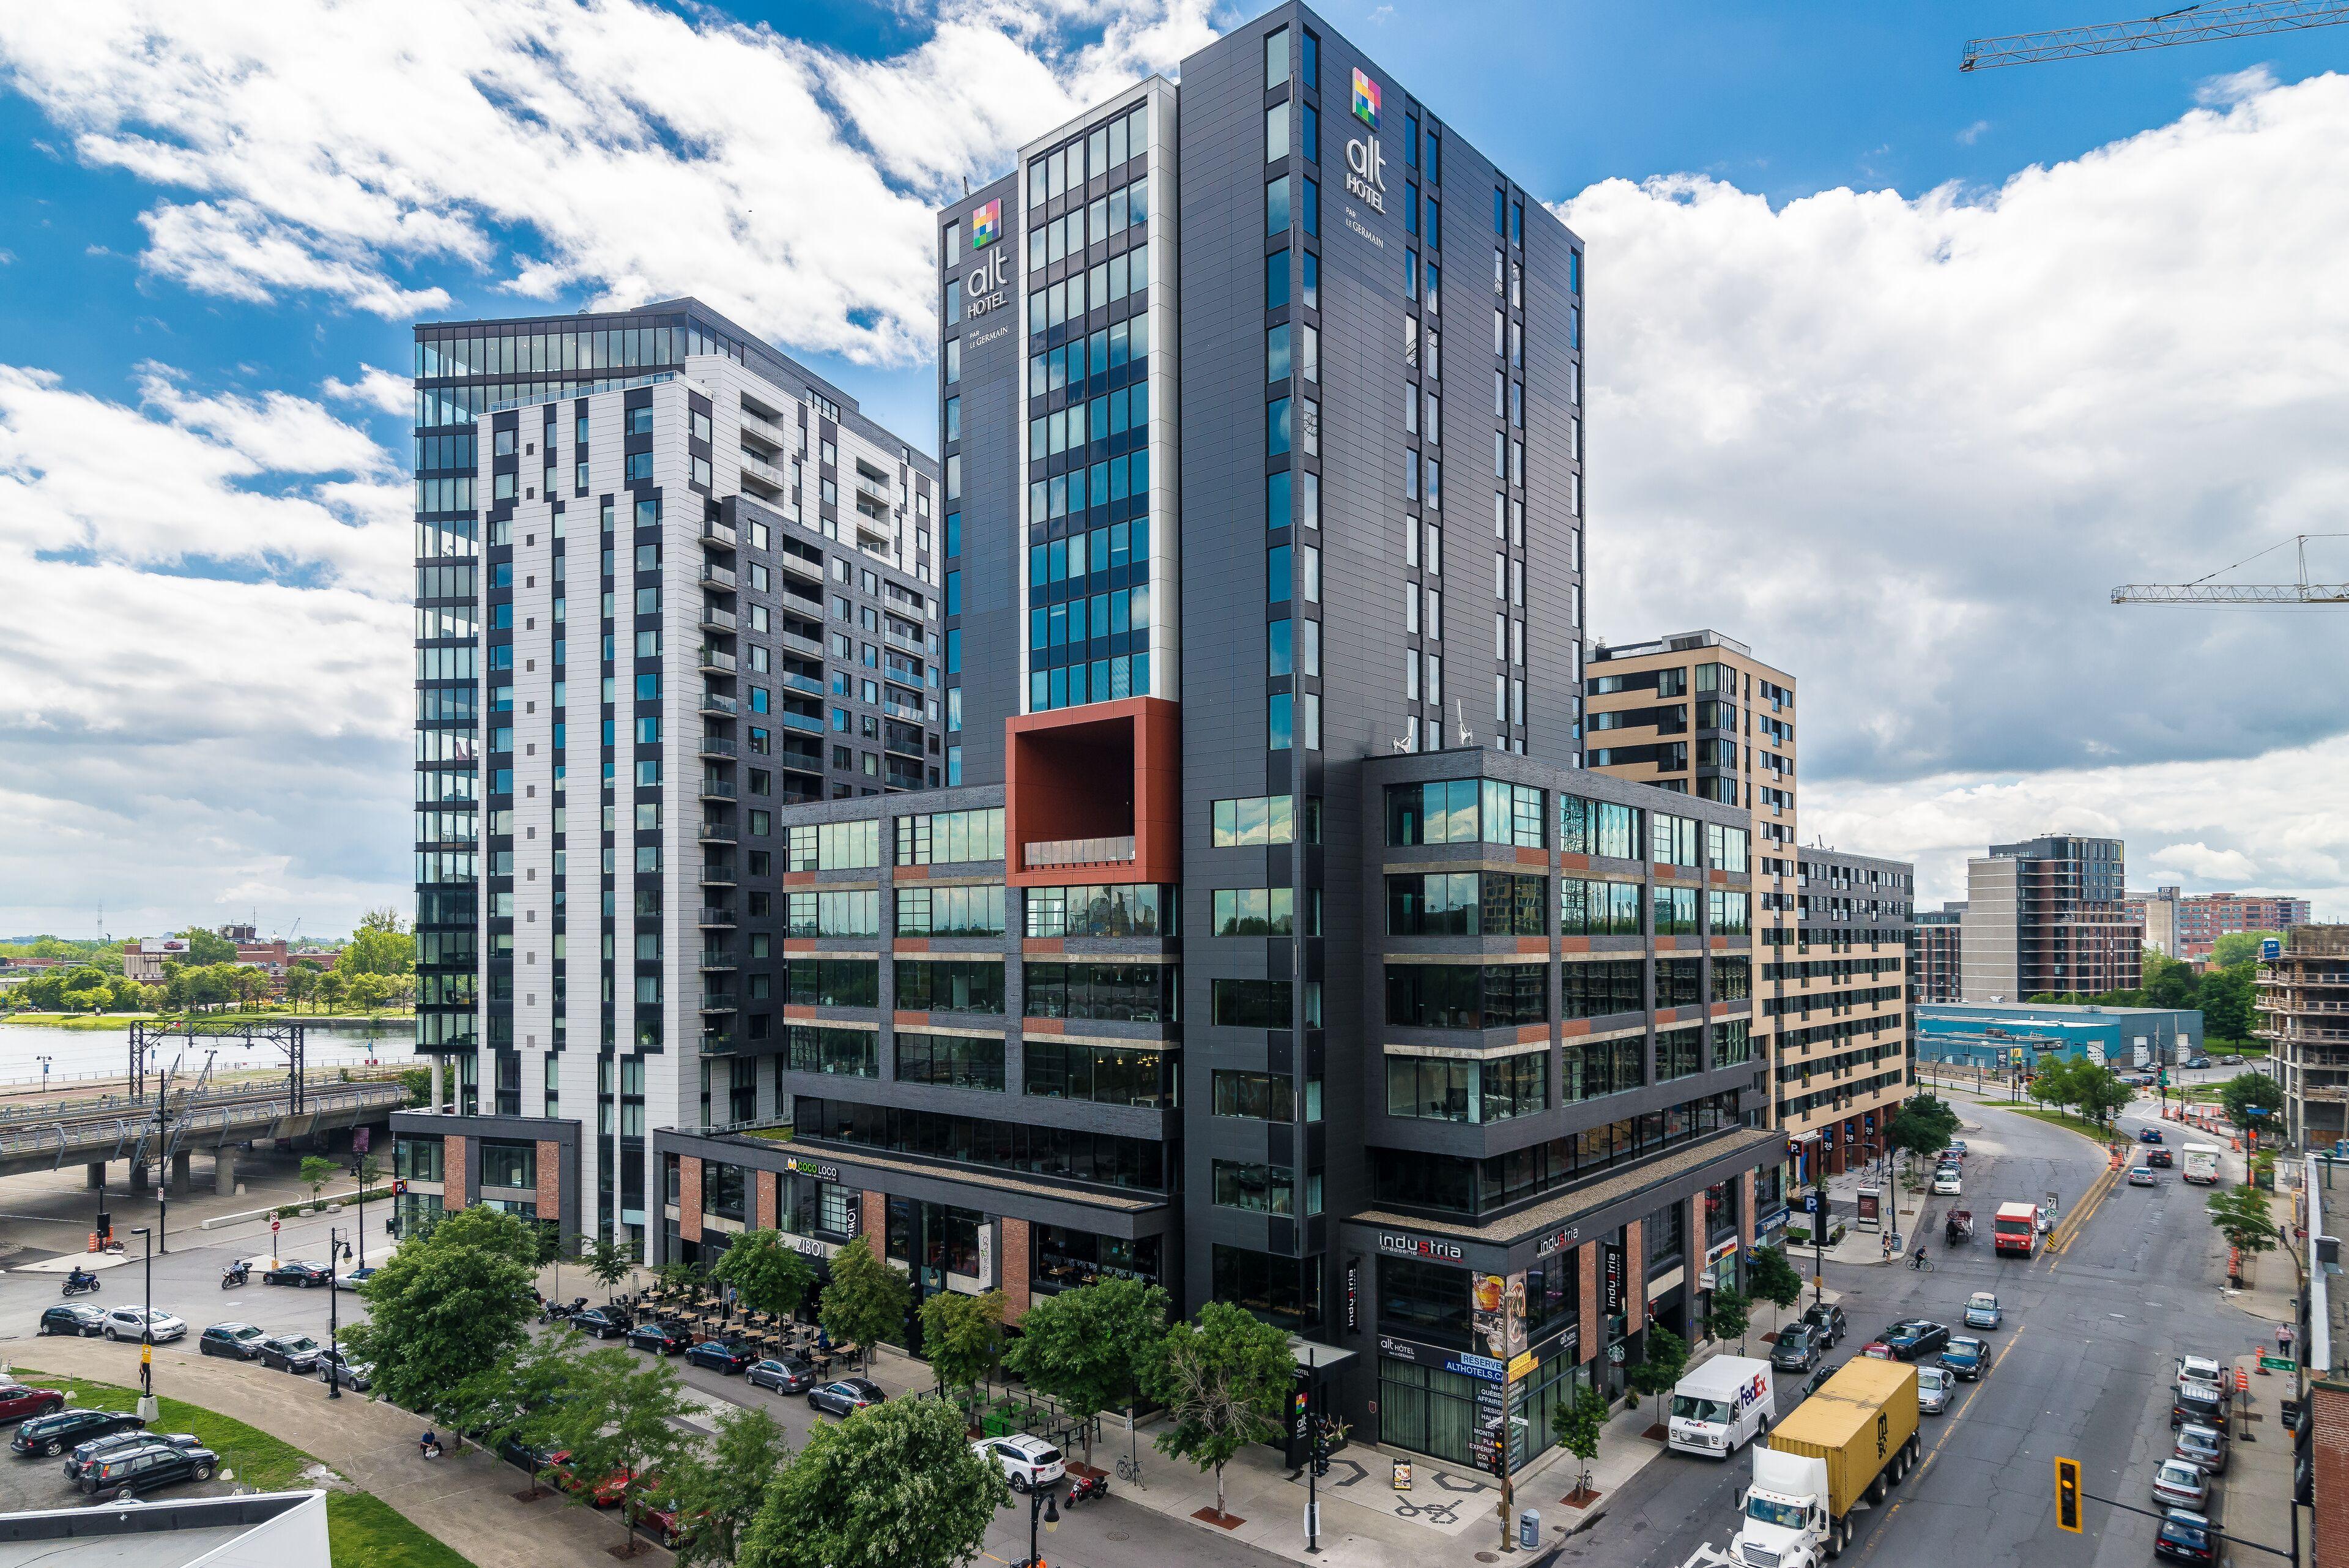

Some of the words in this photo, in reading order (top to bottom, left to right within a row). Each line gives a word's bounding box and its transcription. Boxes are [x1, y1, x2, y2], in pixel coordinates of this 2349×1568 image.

[1346, 135, 1386, 192] alt
[1346, 173, 1386, 214] HOTEL
[1346, 206, 1356, 218] PAR
[1346, 218, 1353, 228] LE
[1353, 221, 1384, 249] GERMAIN
[967, 246, 1008, 297] alt
[968, 291, 1008, 319] HOTEL
[970, 330, 980, 339] PAR
[976, 325, 1009, 346] GERMAIN
[798, 1162, 817, 1173] COCO
[818, 1165, 837, 1176] LOCO
[1806, 1197, 1817, 1211] P
[796, 1238, 824, 1258] ZIBO!
[1379, 1232, 1461, 1258] industria
[1540, 1227, 1578, 1252] industria
[1381, 1244, 1417, 1255] brasserie
[1381, 1338, 1393, 1350] alt
[1463, 1354, 1503, 1370] RÉSERVE
[1740, 1373, 1767, 1410] FedEx
[1297, 1414, 1307, 1427] alt
[1684, 1420, 1709, 1429] FedEx
[1474, 1428, 1494, 1438] MONTR
